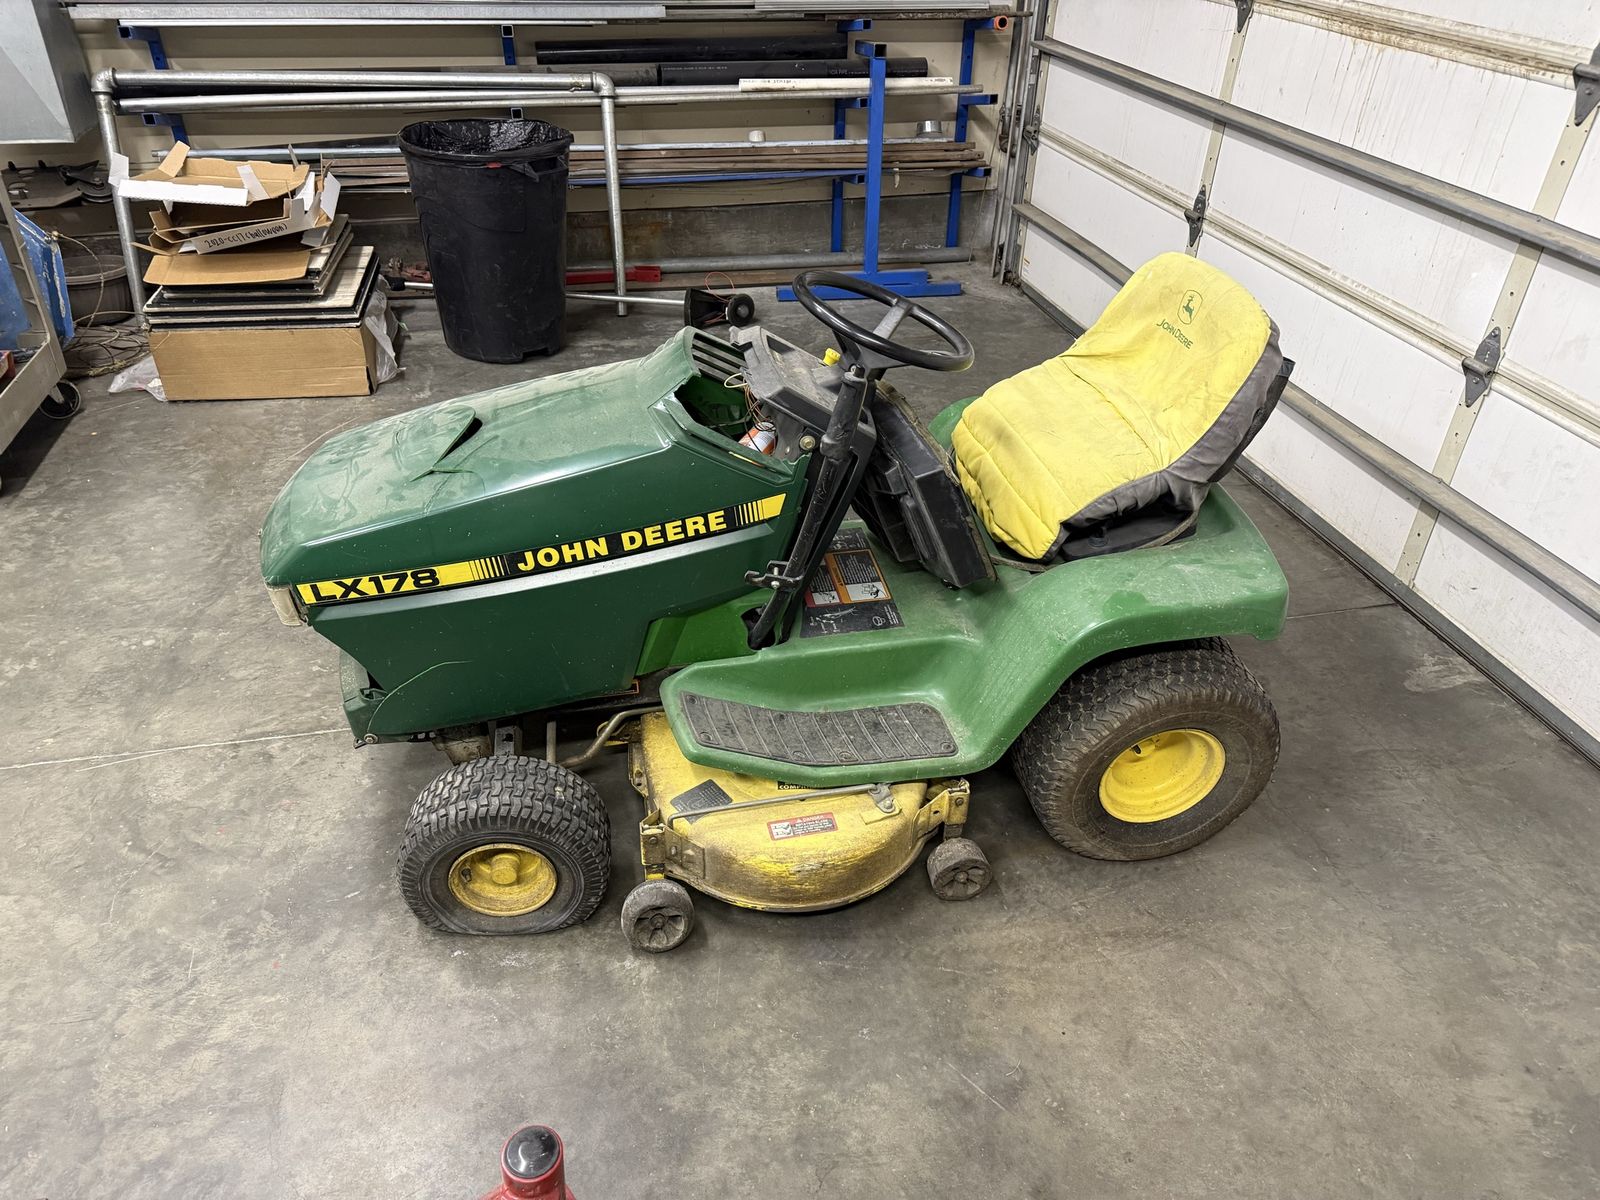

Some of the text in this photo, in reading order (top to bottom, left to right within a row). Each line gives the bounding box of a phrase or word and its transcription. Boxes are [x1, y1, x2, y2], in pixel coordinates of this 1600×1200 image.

[1156, 319, 1194, 349] JOHN DEERE
[517, 509, 728, 572] JOHN DEERE
[310, 568, 441, 602] LX178
